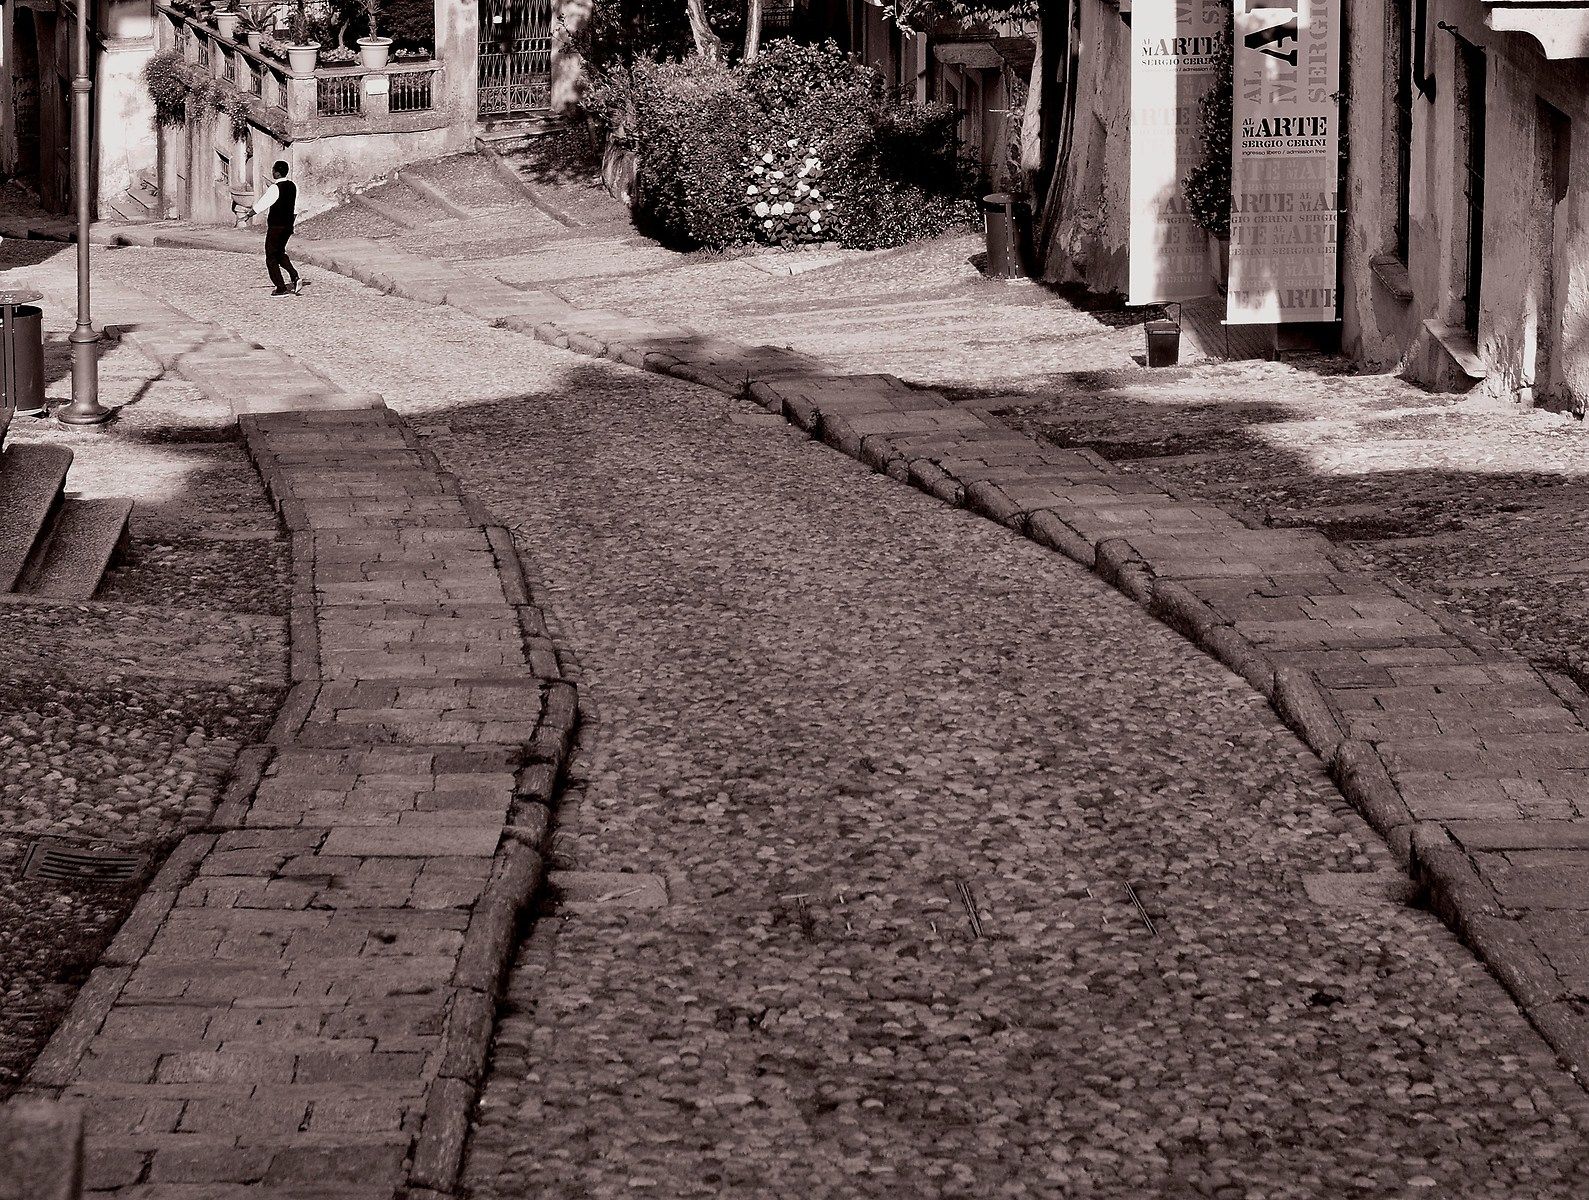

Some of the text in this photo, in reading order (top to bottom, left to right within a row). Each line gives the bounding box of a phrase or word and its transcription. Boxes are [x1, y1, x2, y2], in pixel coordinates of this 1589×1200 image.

[1242, 118, 1255, 126] AL
[1241, 139, 1327, 148] SERGIO CERINI
